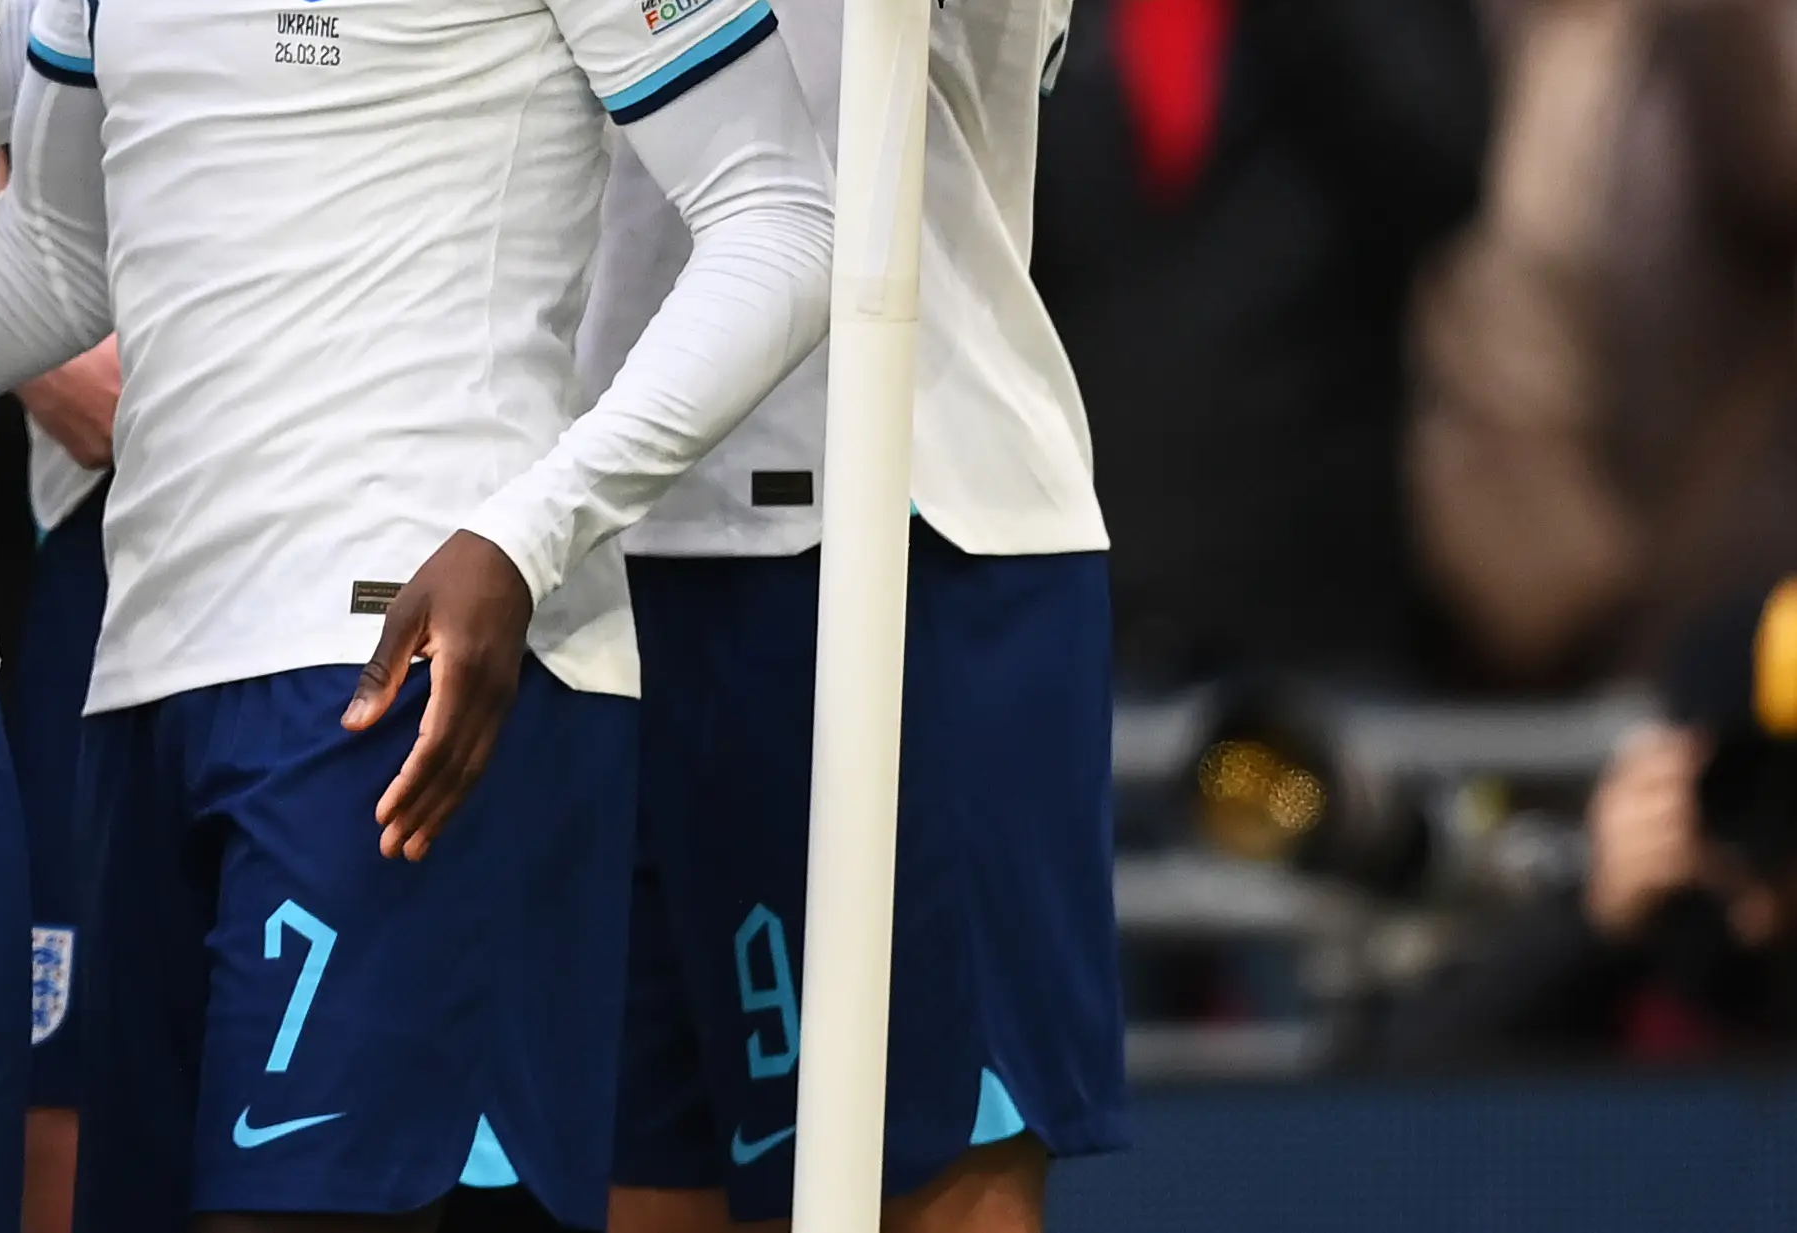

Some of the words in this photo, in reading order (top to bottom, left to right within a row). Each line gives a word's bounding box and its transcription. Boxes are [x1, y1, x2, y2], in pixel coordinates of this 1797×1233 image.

[275, 42, 341, 67] 26.03.23
[277, 13, 339, 39] UKRAINE
[263, 899, 338, 1073] 7
[734, 902, 799, 1079] 9
